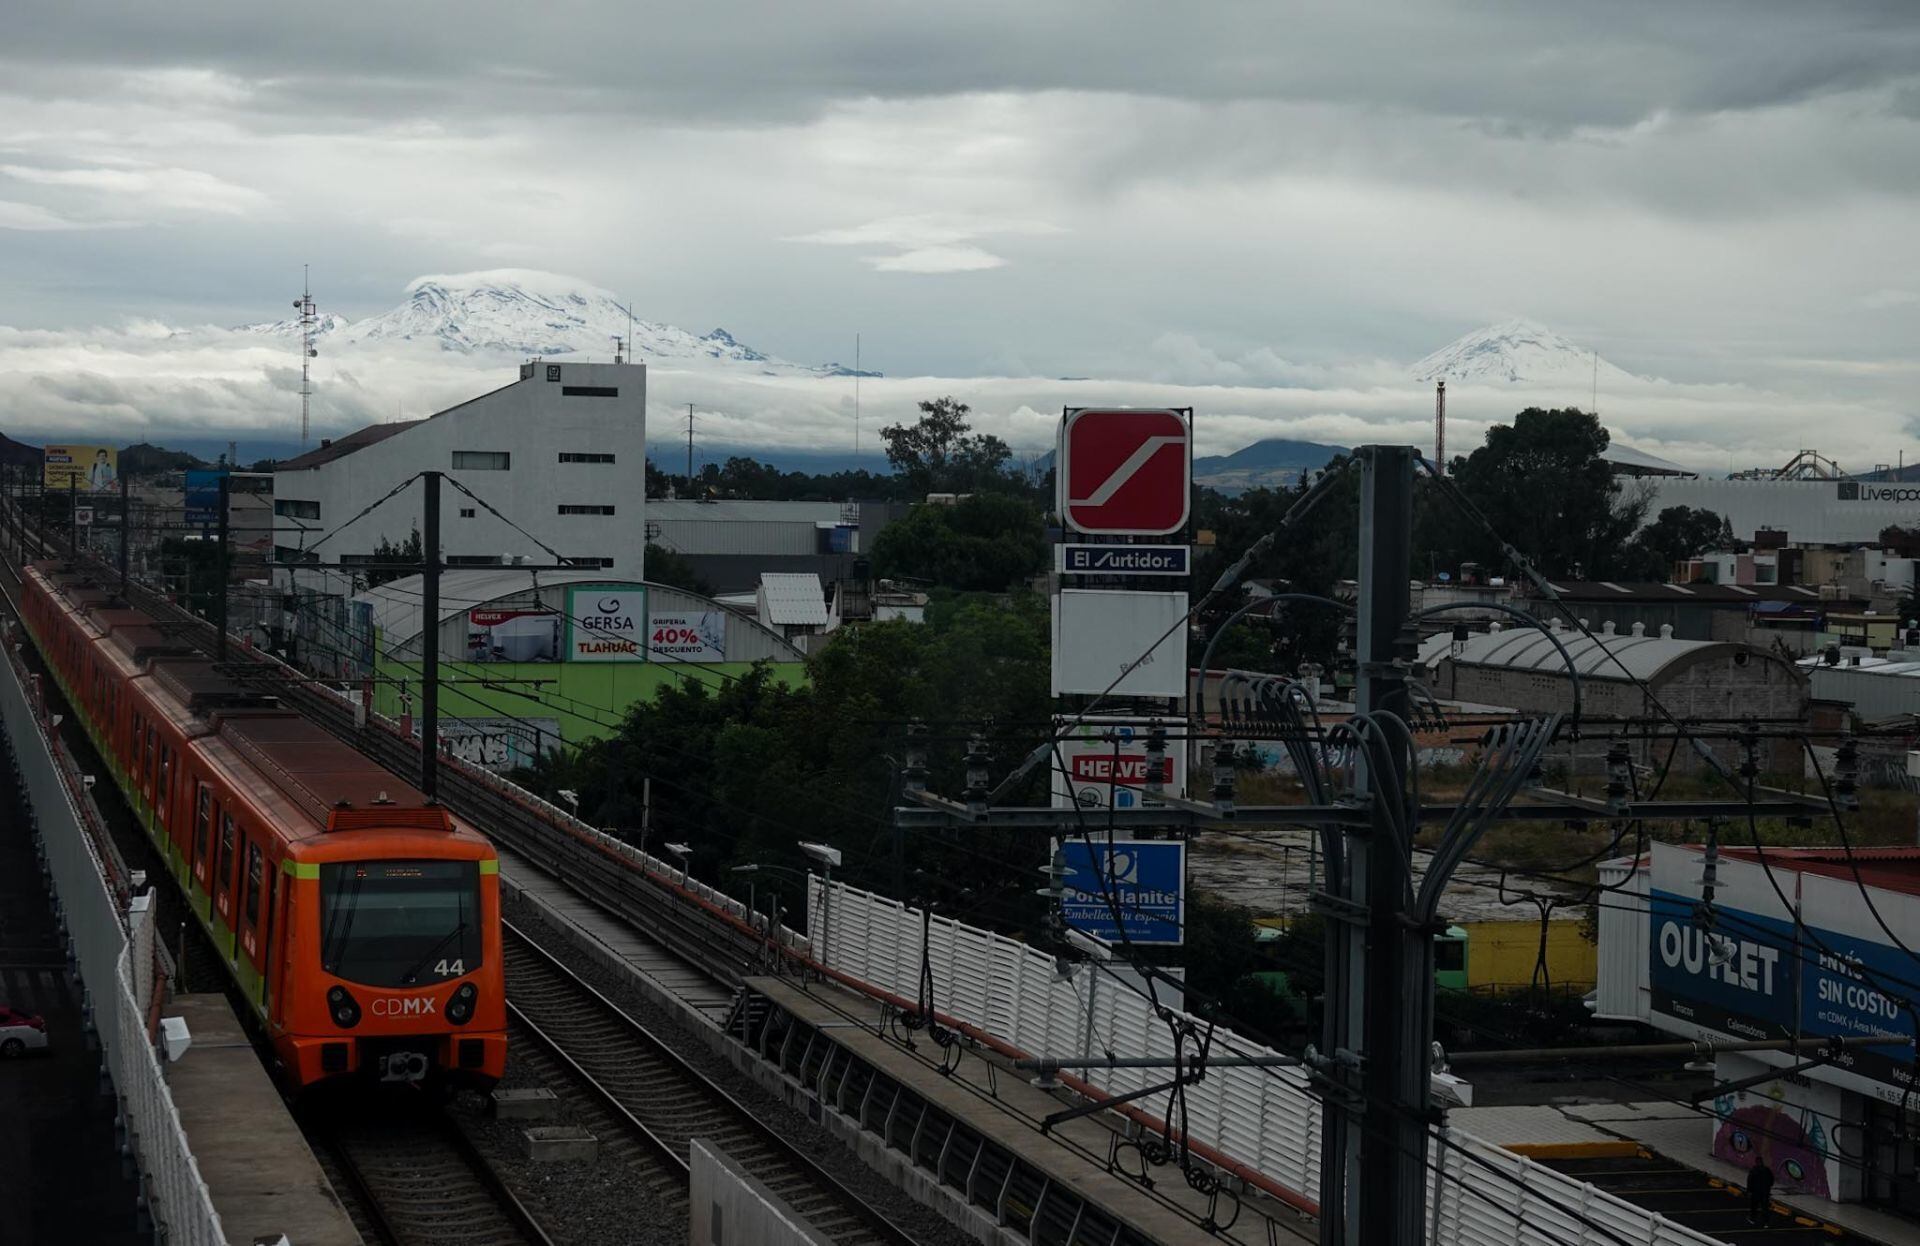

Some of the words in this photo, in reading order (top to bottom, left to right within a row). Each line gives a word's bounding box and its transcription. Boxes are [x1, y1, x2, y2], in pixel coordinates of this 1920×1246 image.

[1074, 552, 1090, 567] El
[1095, 551, 1172, 569] Surtidor
[583, 616, 634, 632] GERSA
[653, 629, 698, 643] 40%
[1079, 760, 1169, 779] HELVE
[1063, 908, 1113, 920] Embellec
[1660, 920, 1779, 996] OUTLET
[434, 959, 465, 976] 44
[371, 998, 436, 1015] CDMX
[1818, 978, 1843, 1004] SIN
[1846, 986, 1899, 1020] COSTO
